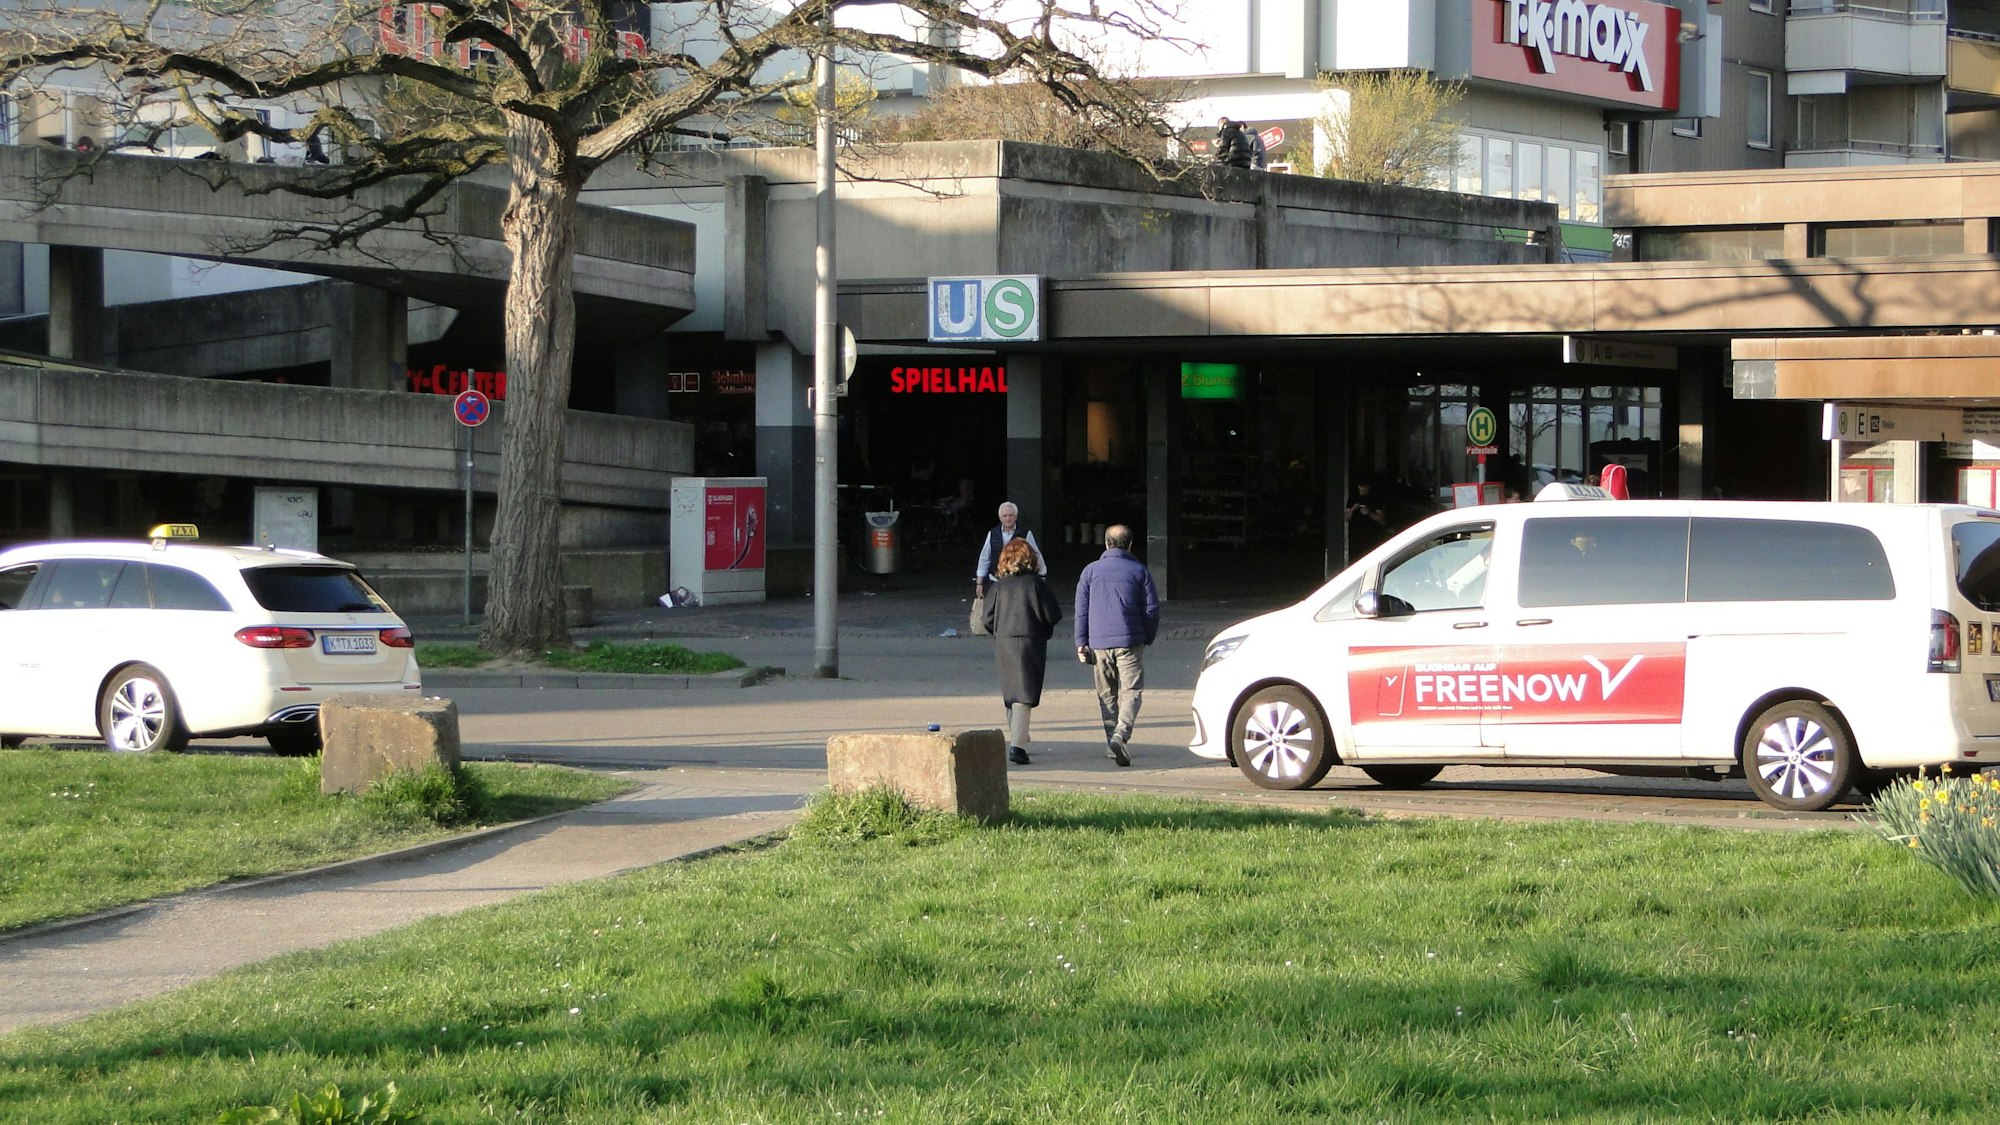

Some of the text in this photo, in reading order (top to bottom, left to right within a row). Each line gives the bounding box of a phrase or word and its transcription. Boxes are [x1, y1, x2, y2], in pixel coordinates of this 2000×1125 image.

[938, 284, 1025, 334] U S
[1476, 416, 1489, 437] H
[1858, 413, 1865, 434] E
[171, 526, 196, 536] TAXI
[1473, 663, 1497, 672] AUF
[1415, 673, 1587, 703] FREENOW
